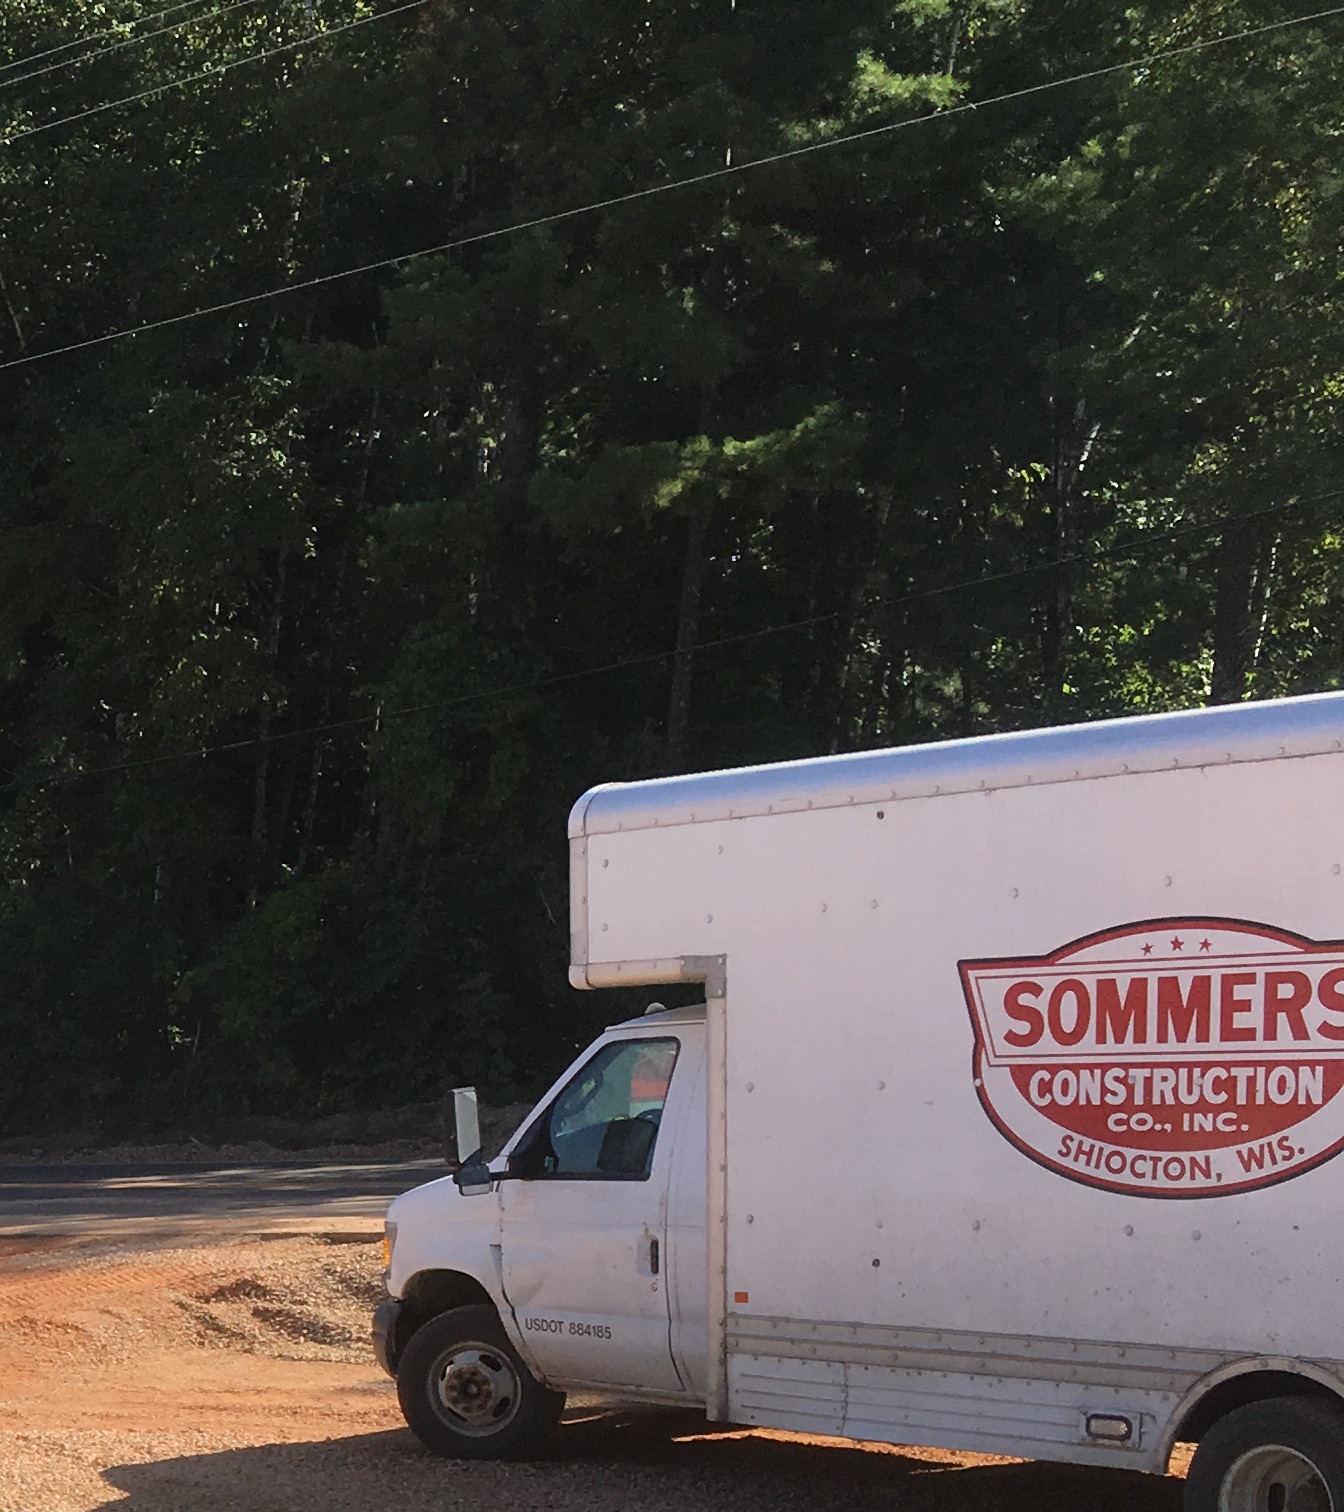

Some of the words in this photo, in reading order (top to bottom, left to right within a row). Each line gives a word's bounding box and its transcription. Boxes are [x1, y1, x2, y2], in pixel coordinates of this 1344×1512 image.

[1029, 1066, 1324, 1106] CONSTRUCTION
[1107, 1112, 1171, 1134] CO.,
[1183, 1112, 1250, 1132] INC.
[1057, 1134, 1223, 1182] SHIOCTON,
[1236, 1135, 1306, 1174] WIS.
[525, 1318, 564, 1334] USDOT
[568, 1322, 612, 1340] 884185
